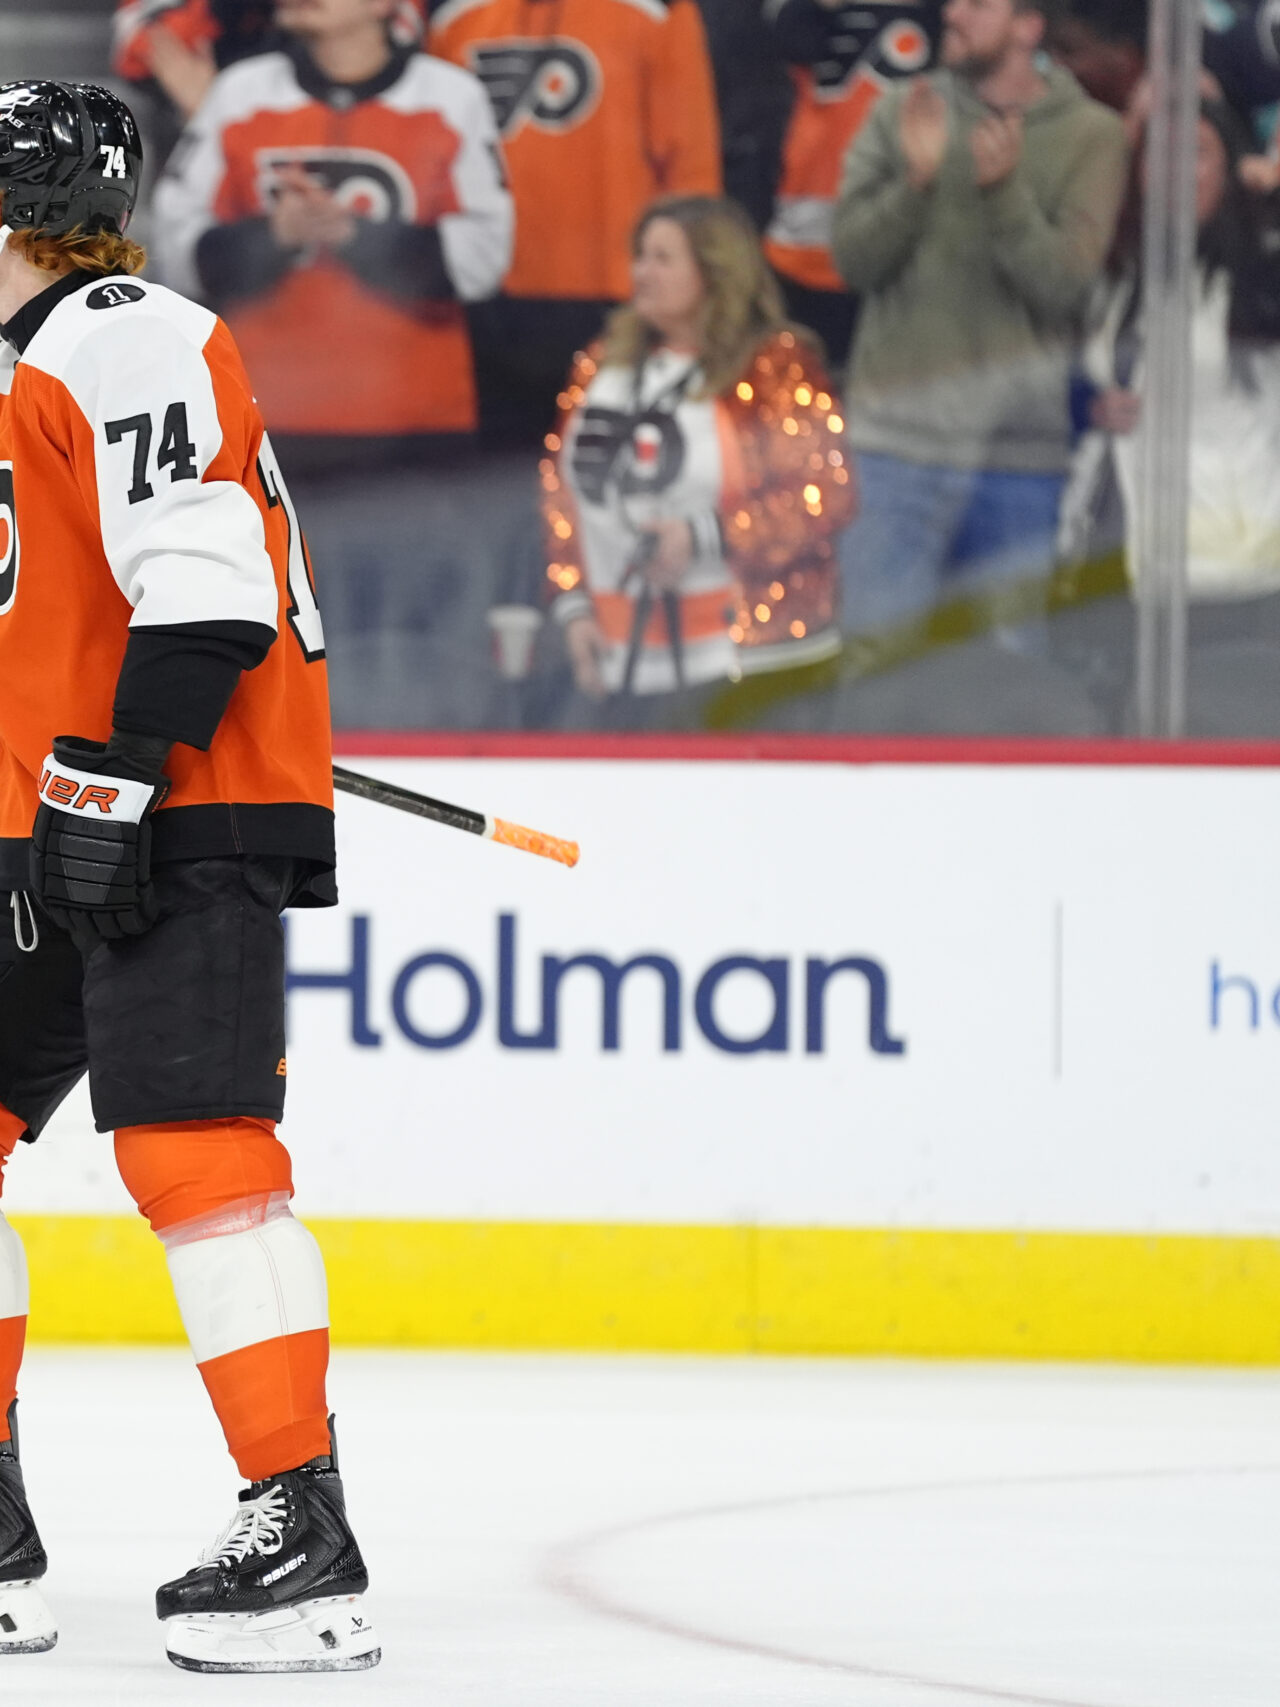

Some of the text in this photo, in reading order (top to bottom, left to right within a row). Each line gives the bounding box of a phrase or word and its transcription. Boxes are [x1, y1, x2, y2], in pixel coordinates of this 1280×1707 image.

[100, 145, 127, 178] 74
[104, 401, 198, 505] 74
[284, 911, 907, 1056] Holman
[262, 1552, 308, 1588] BAUER
